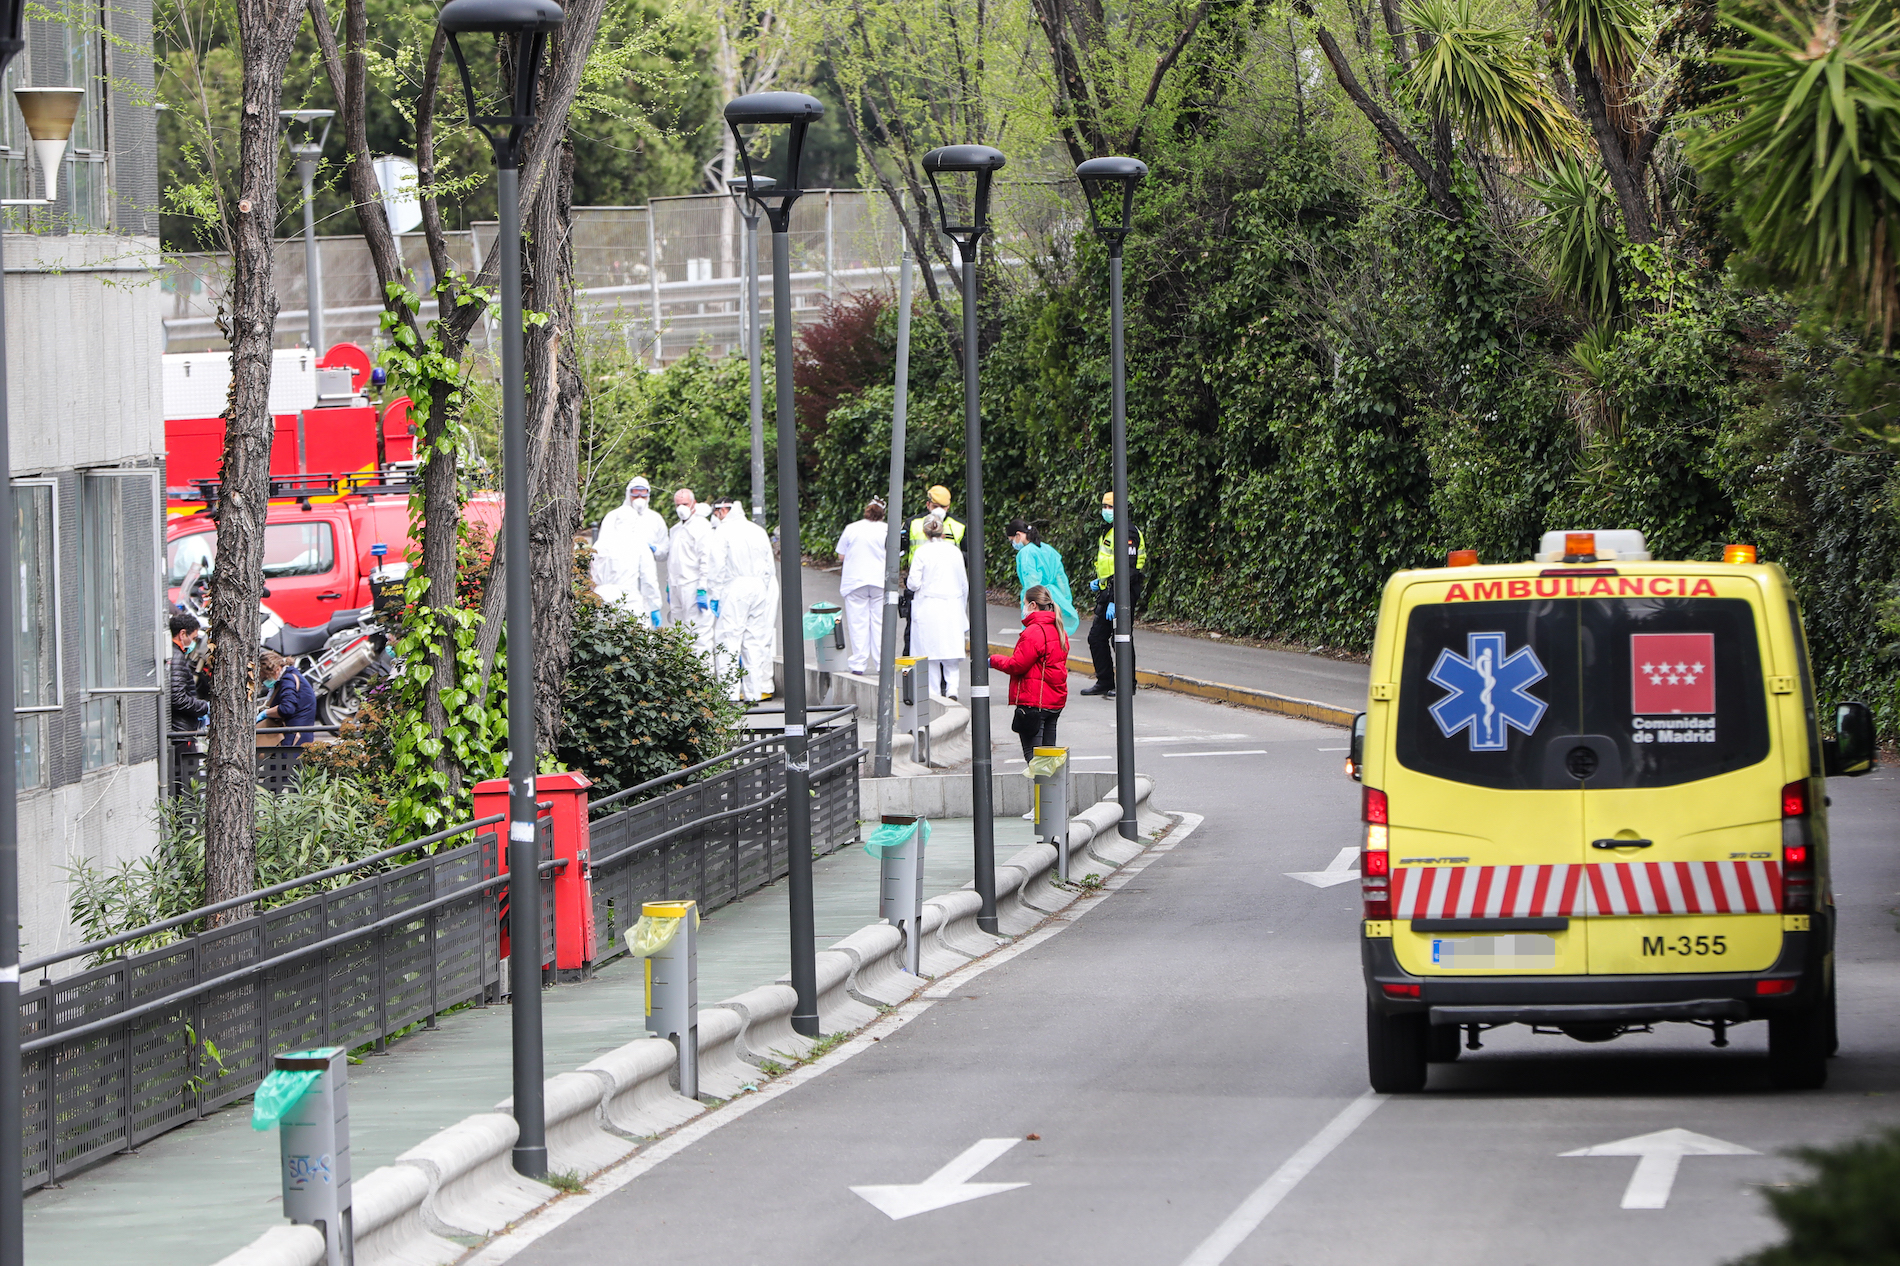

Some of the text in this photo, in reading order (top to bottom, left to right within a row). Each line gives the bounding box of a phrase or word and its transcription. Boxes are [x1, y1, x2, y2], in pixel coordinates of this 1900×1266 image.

[1445, 578, 1717, 602] AMBULANCIA
[1632, 717, 1716, 730] Comunidad
[1632, 730, 1716, 743] de Madrid
[1642, 935, 1727, 956] M-355
